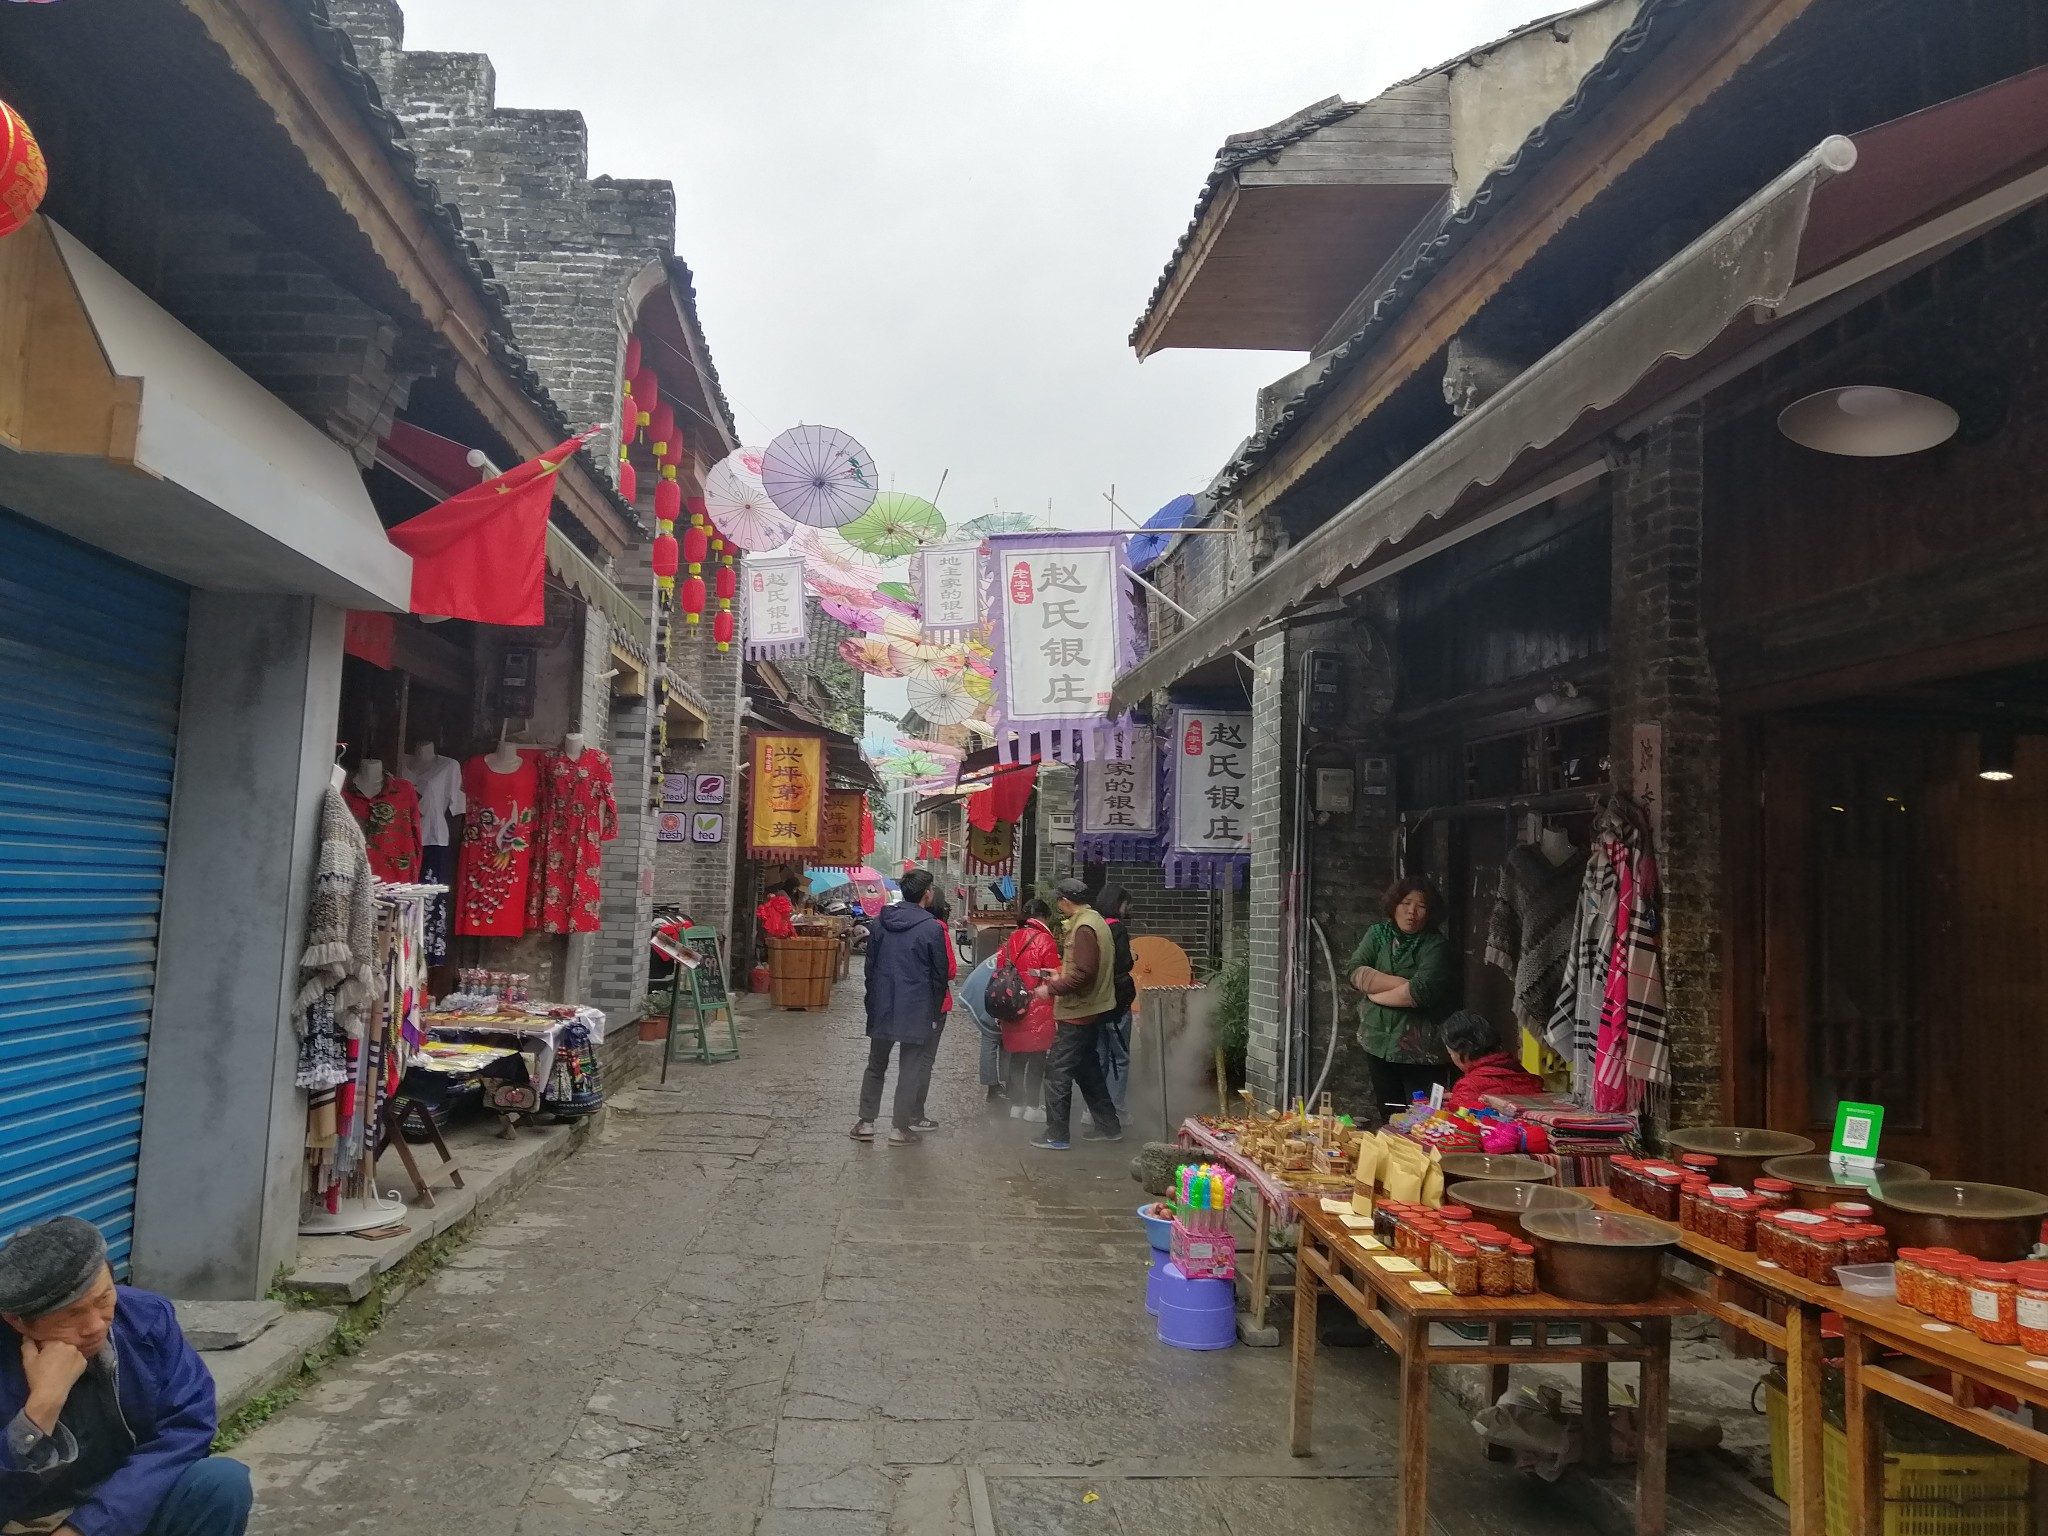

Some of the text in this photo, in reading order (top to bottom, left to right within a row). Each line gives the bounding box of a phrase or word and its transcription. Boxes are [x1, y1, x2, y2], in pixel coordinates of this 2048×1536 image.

[765, 572, 791, 635] 赵氏银庄
[939, 556, 964, 621] 地主家的银庄
[1013, 568, 1031, 602] 老字号
[1037, 562, 1093, 704] 赵氏银庄
[696, 792, 723, 802] coffee
[770, 746, 804, 839] 兴坪第一辣
[1203, 722, 1247, 841] 赵氏银庄
[659, 829, 683, 840] fresh
[698, 830, 715, 840] tea
[827, 800, 848, 859] 兴坪第一辣
